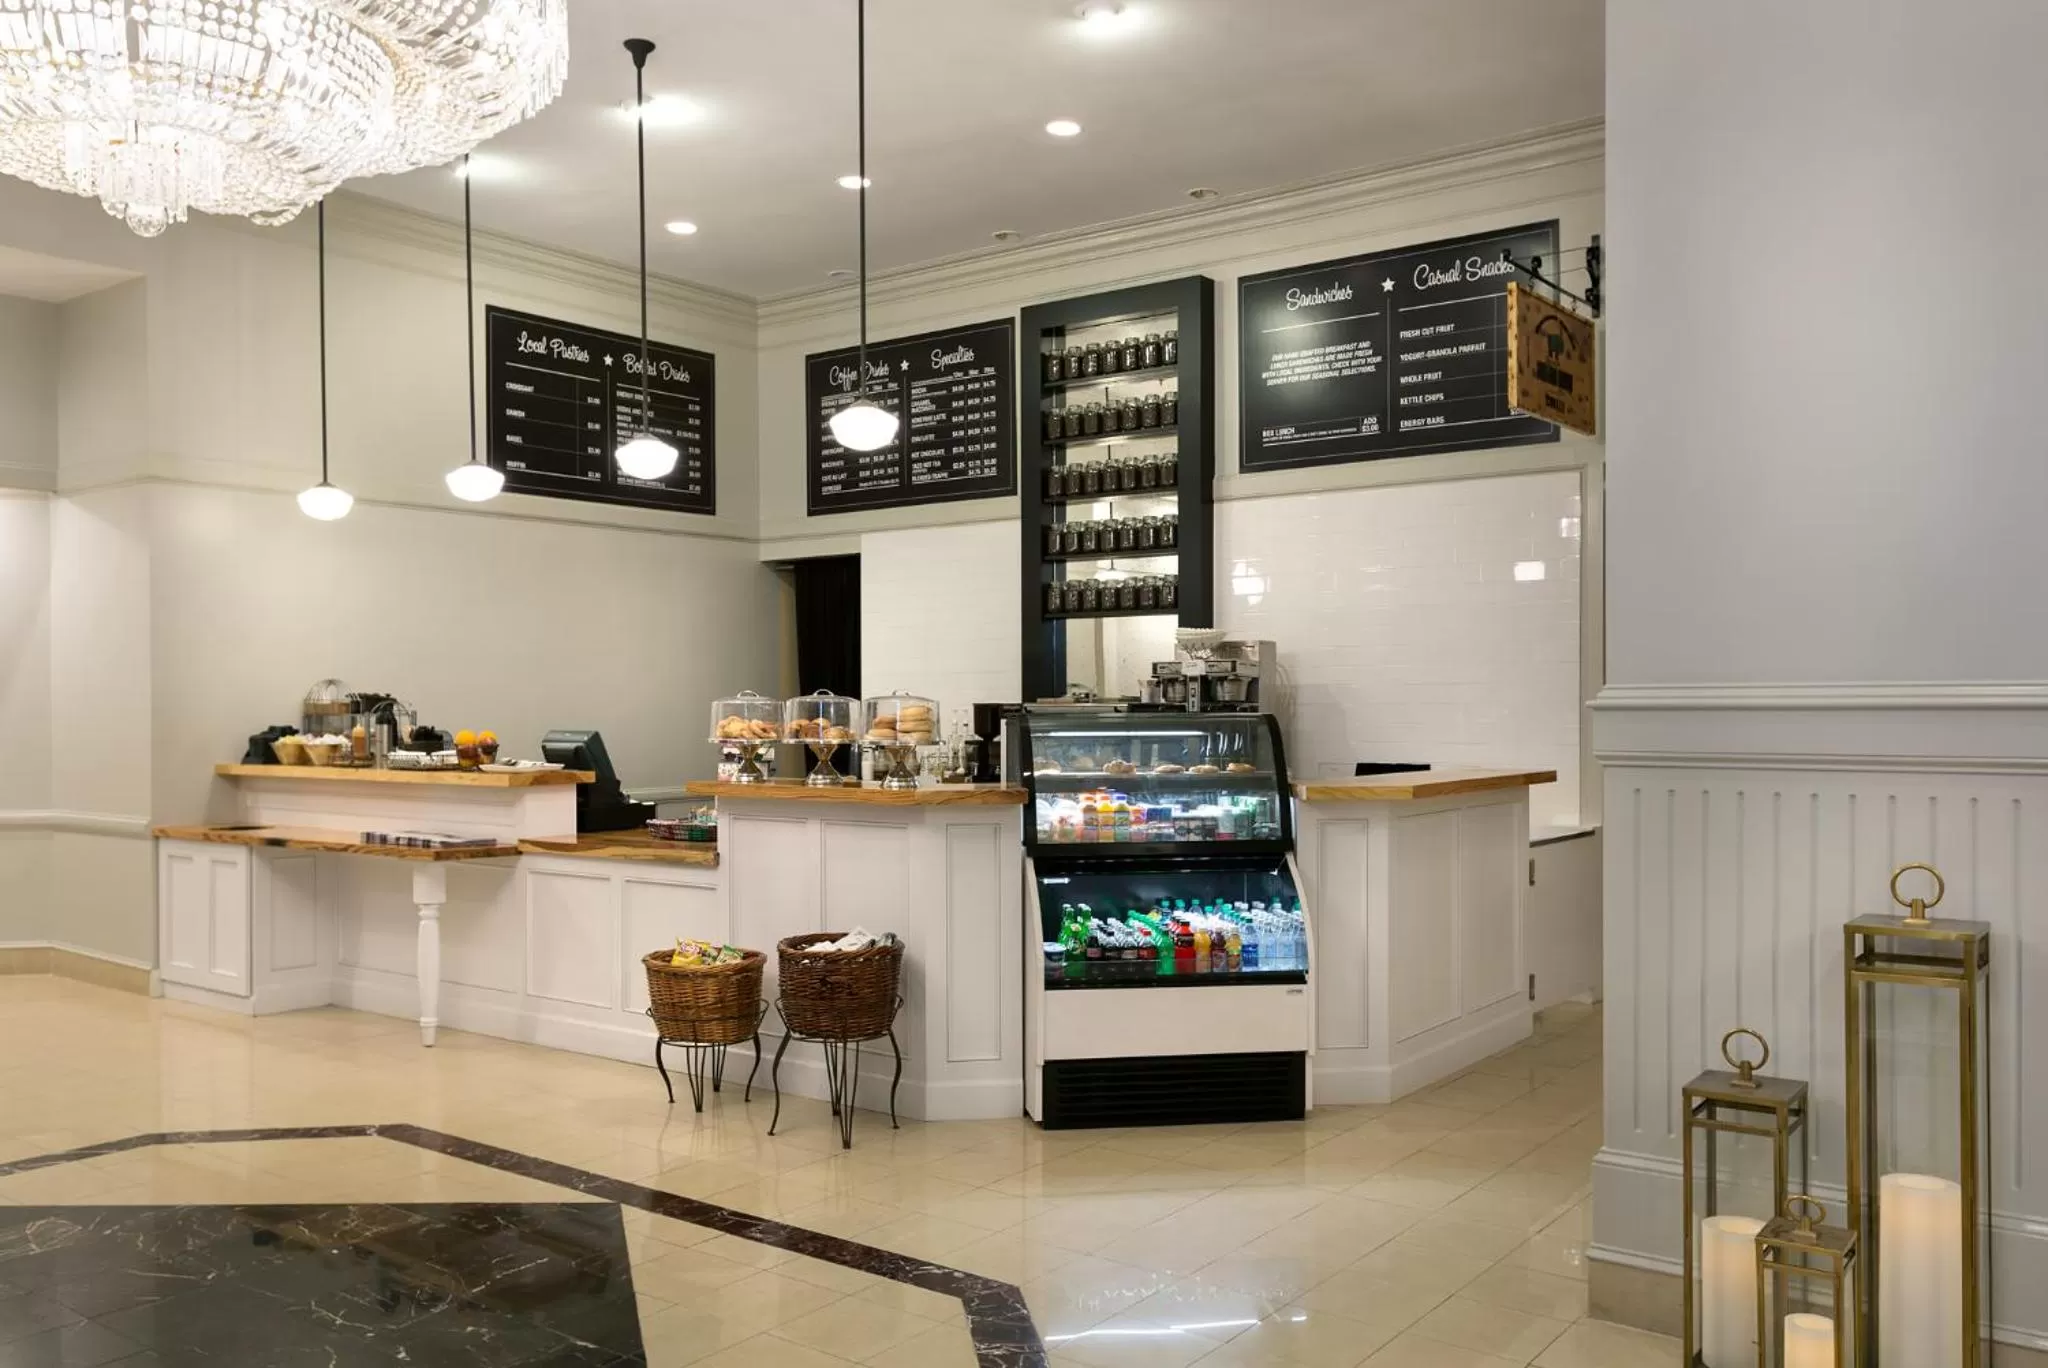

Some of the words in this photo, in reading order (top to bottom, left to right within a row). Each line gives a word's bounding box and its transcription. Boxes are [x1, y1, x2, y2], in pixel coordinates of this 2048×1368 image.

[1413, 259, 1463, 291] Casual
[1286, 281, 1353, 311] Sandwiches
[1400, 329, 1421, 340] FRESH
[1421, 326, 1434, 336] CUT
[1435, 323, 1456, 334] FRUIT
[516, 330, 548, 355] Local
[549, 338, 590, 363] Pastries
[1458, 342, 1487, 354] PARFAIT
[931, 345, 975, 372] Specialties
[658, 360, 691, 383] Drinks
[829, 365, 858, 392] Coffee
[1400, 374, 1423, 384] WHOLE
[1423, 371, 1443, 381] FRUIT
[1400, 395, 1424, 406] KETTLE
[1424, 392, 1445, 402] CHIPS
[1400, 417, 1426, 428] ENERGY
[1426, 415, 1445, 426] BARS
